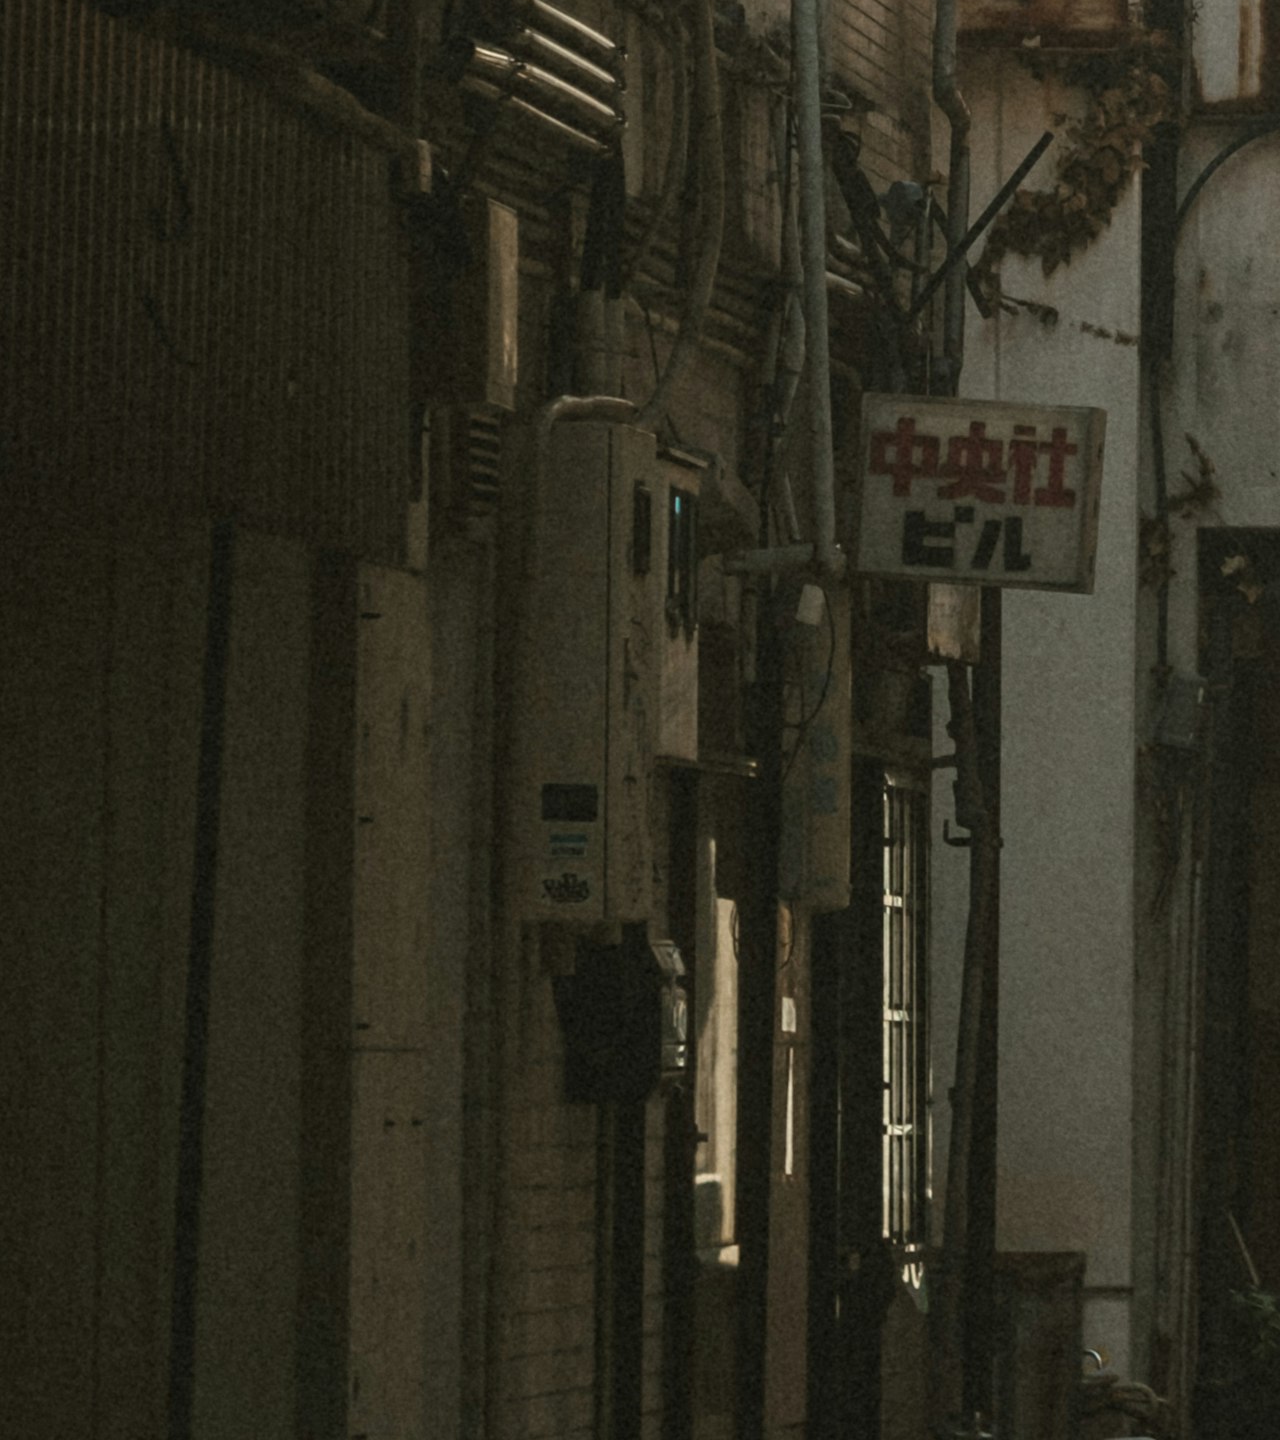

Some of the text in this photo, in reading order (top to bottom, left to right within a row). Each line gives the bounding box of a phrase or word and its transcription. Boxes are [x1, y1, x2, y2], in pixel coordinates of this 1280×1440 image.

[869, 417, 1078, 507] 中央社
[904, 506, 1031, 571] ビル
